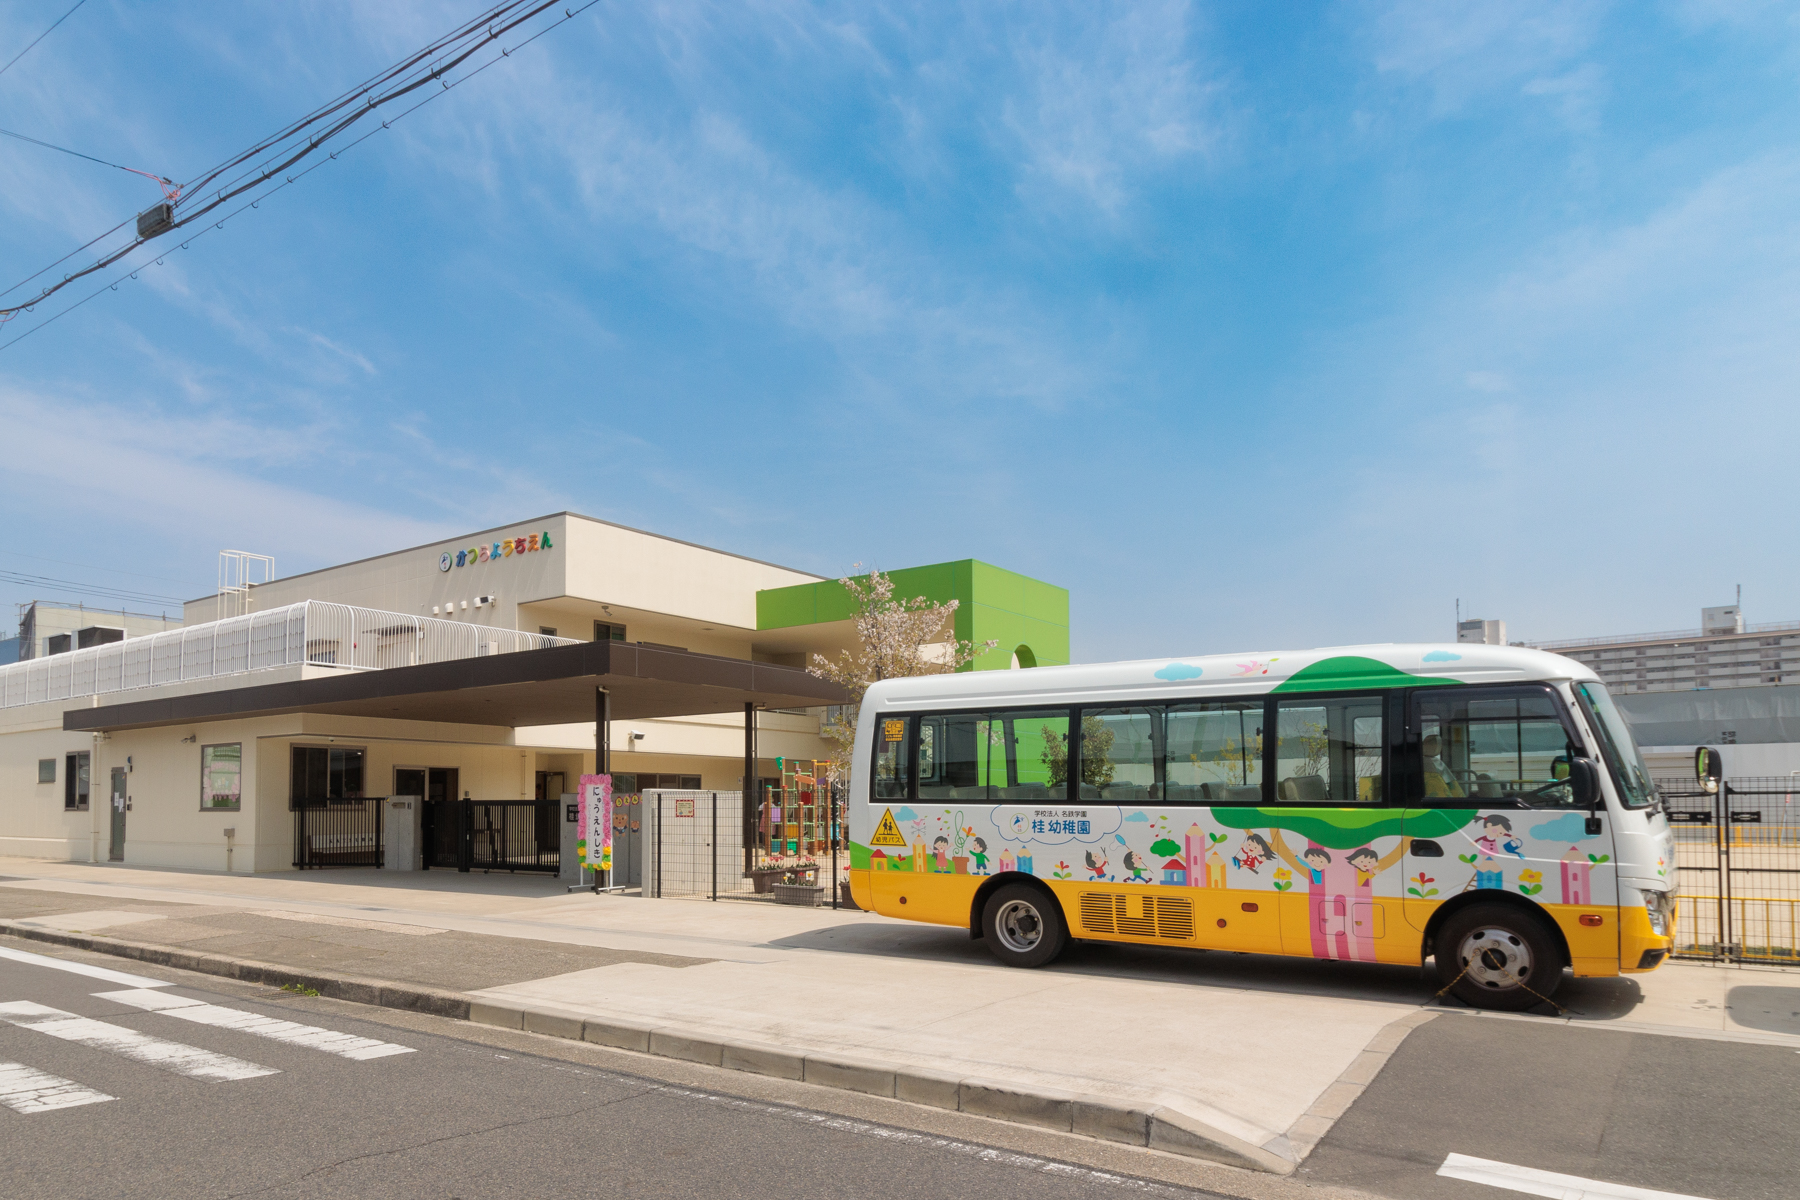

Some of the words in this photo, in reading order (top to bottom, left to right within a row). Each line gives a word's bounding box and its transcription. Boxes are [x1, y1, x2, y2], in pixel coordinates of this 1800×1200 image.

[455, 531, 553, 567] かつらようちえん
[1034, 810, 1060, 818] 学校法人
[1061, 810, 1088, 818] 名鉄学園
[592, 786, 602, 859] にゅうえんしき
[1031, 819, 1091, 835] 桂幼稚園
[875, 836, 901, 844] 幼児バス
